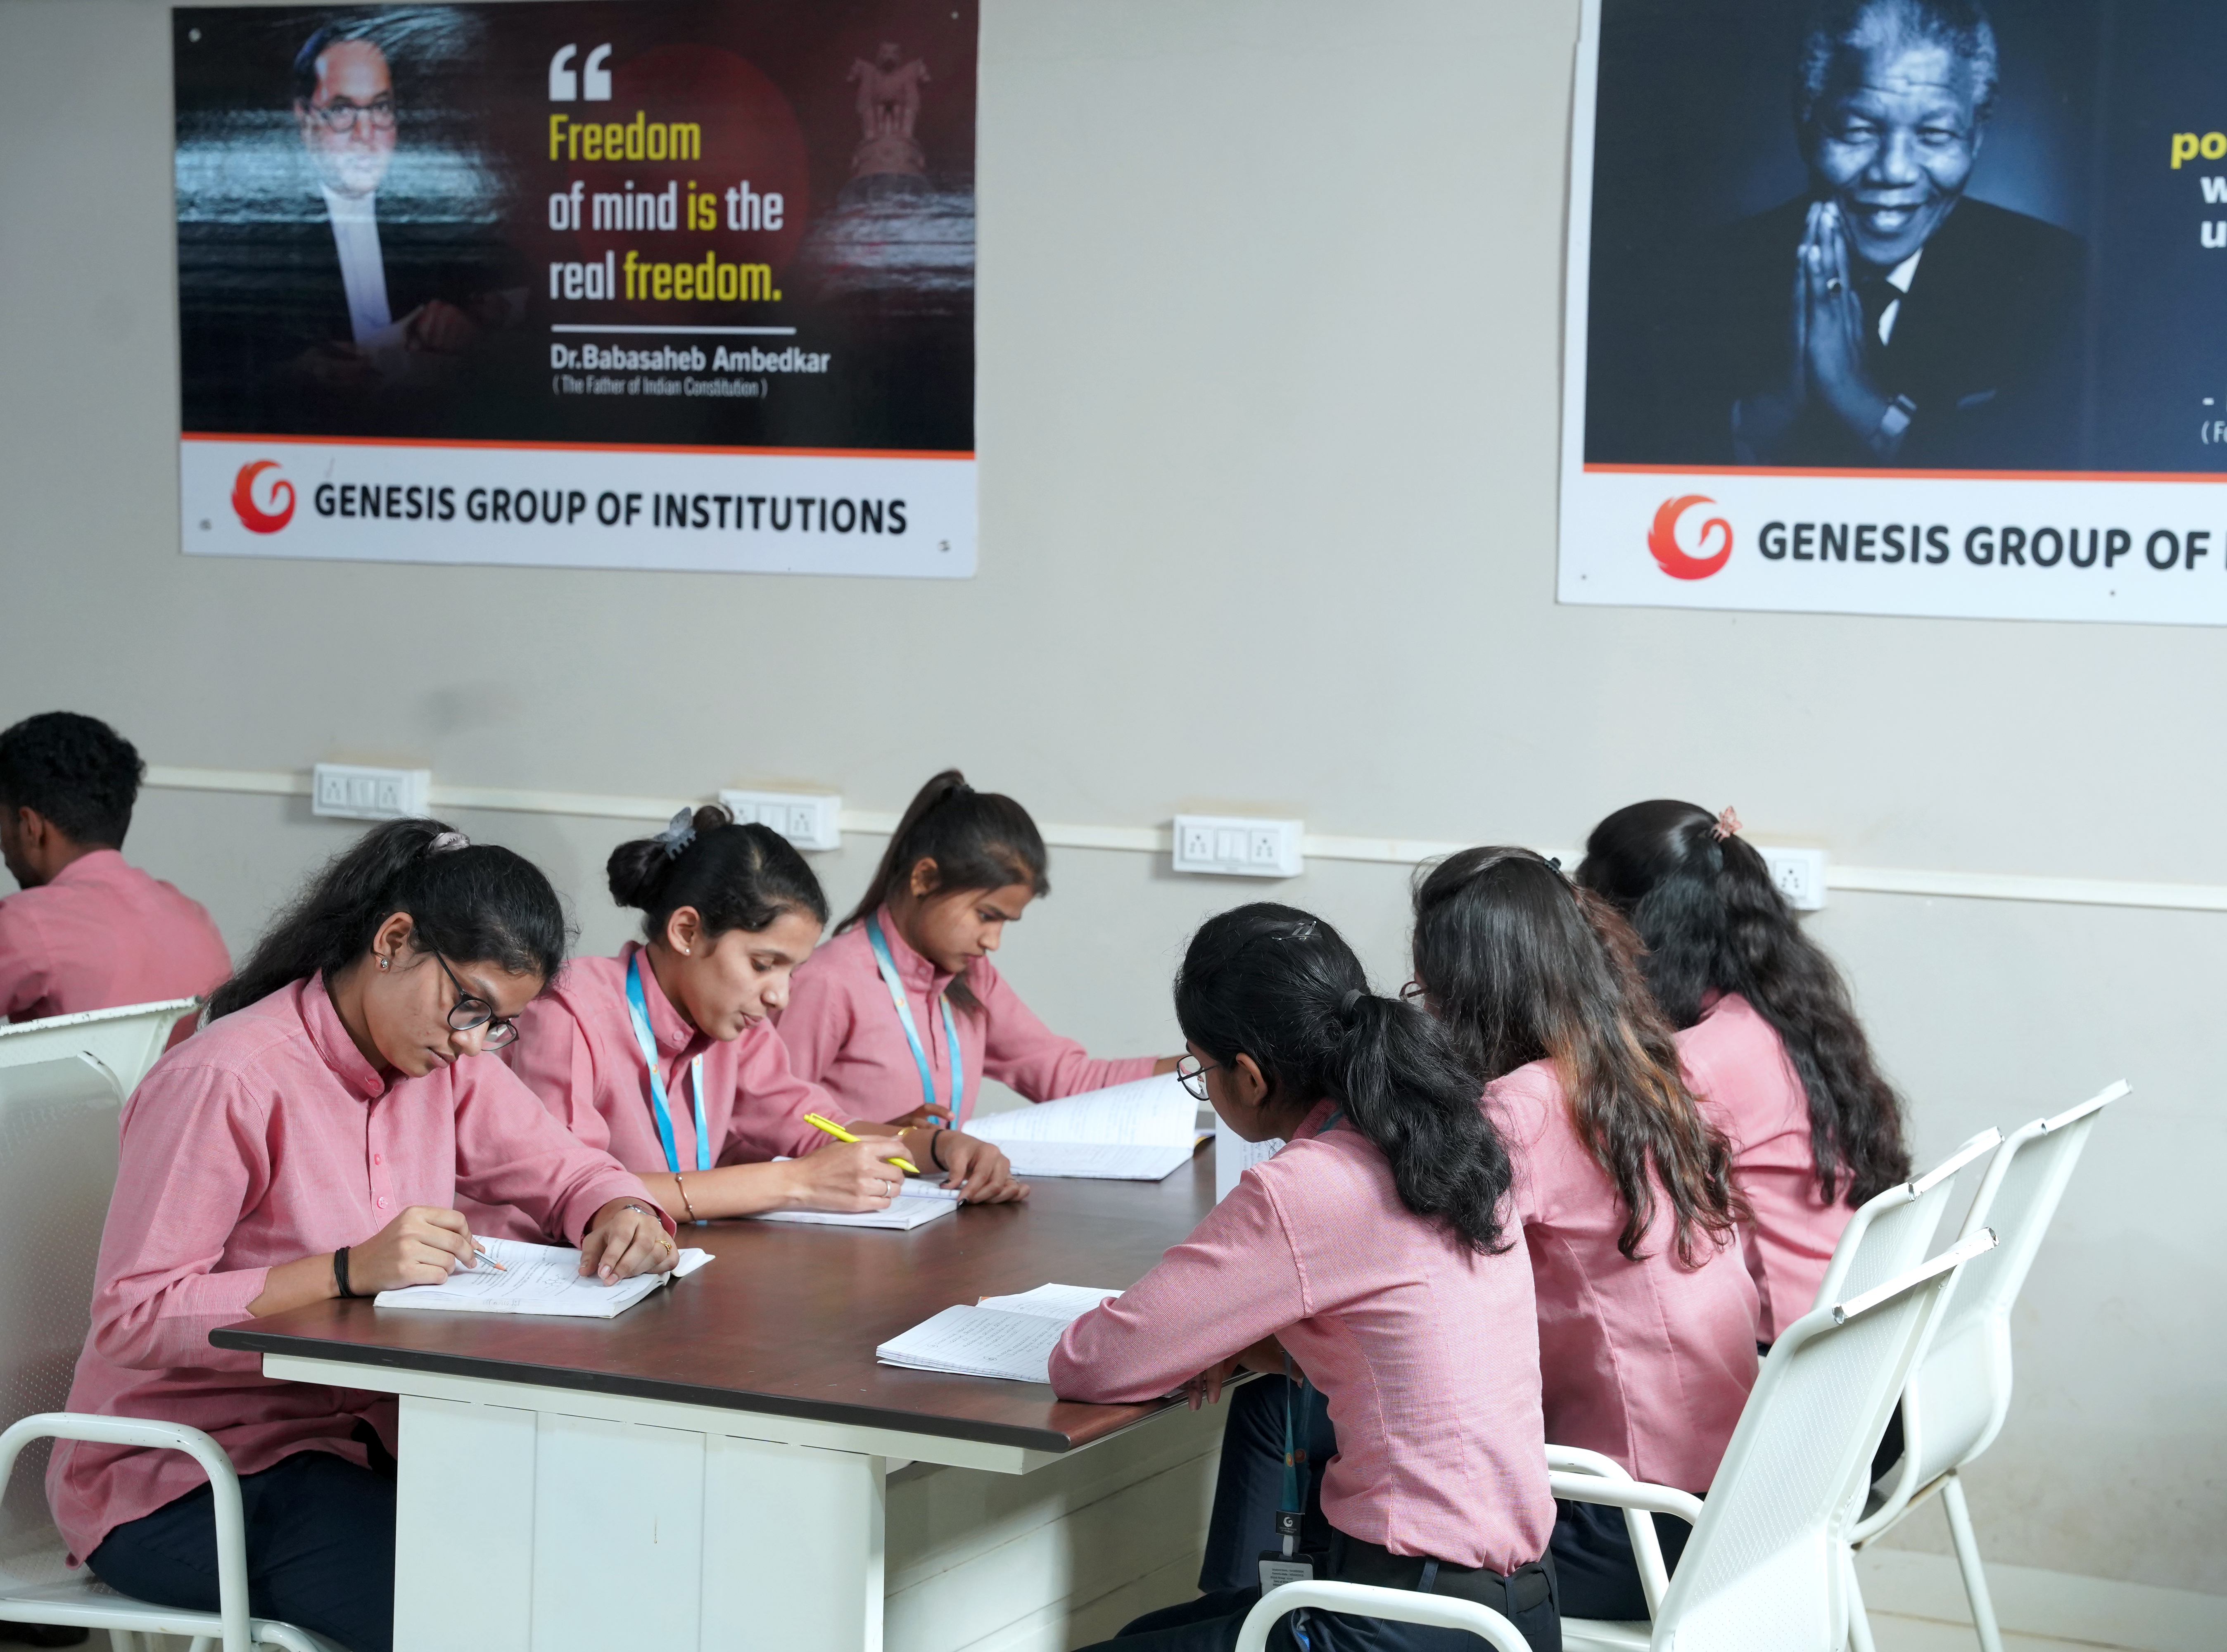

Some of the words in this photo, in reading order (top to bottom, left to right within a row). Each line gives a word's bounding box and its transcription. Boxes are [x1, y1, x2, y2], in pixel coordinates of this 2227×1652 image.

[549, 109, 701, 161] Freedom
[548, 180, 585, 231] of
[592, 180, 678, 230] mind
[687, 180, 717, 230] is
[724, 180, 784, 231] the
[549, 249, 615, 300] real
[623, 250, 782, 301] freedom.
[550, 343, 707, 372] Dr.Babasaheb
[711, 345, 832, 373] Ambedkar
[586, 375, 626, 395] Father
[627, 375, 641, 395] of
[642, 376, 683, 396] Indian
[314, 482, 456, 521] GENESIS
[465, 487, 587, 525] GROUP
[596, 491, 643, 527] OF
[653, 493, 907, 535] INSTITUTIONS
[1758, 520, 1950, 565] GENESIS
[1963, 525, 2132, 569] GROUP
[2145, 529, 2211, 571] OF
